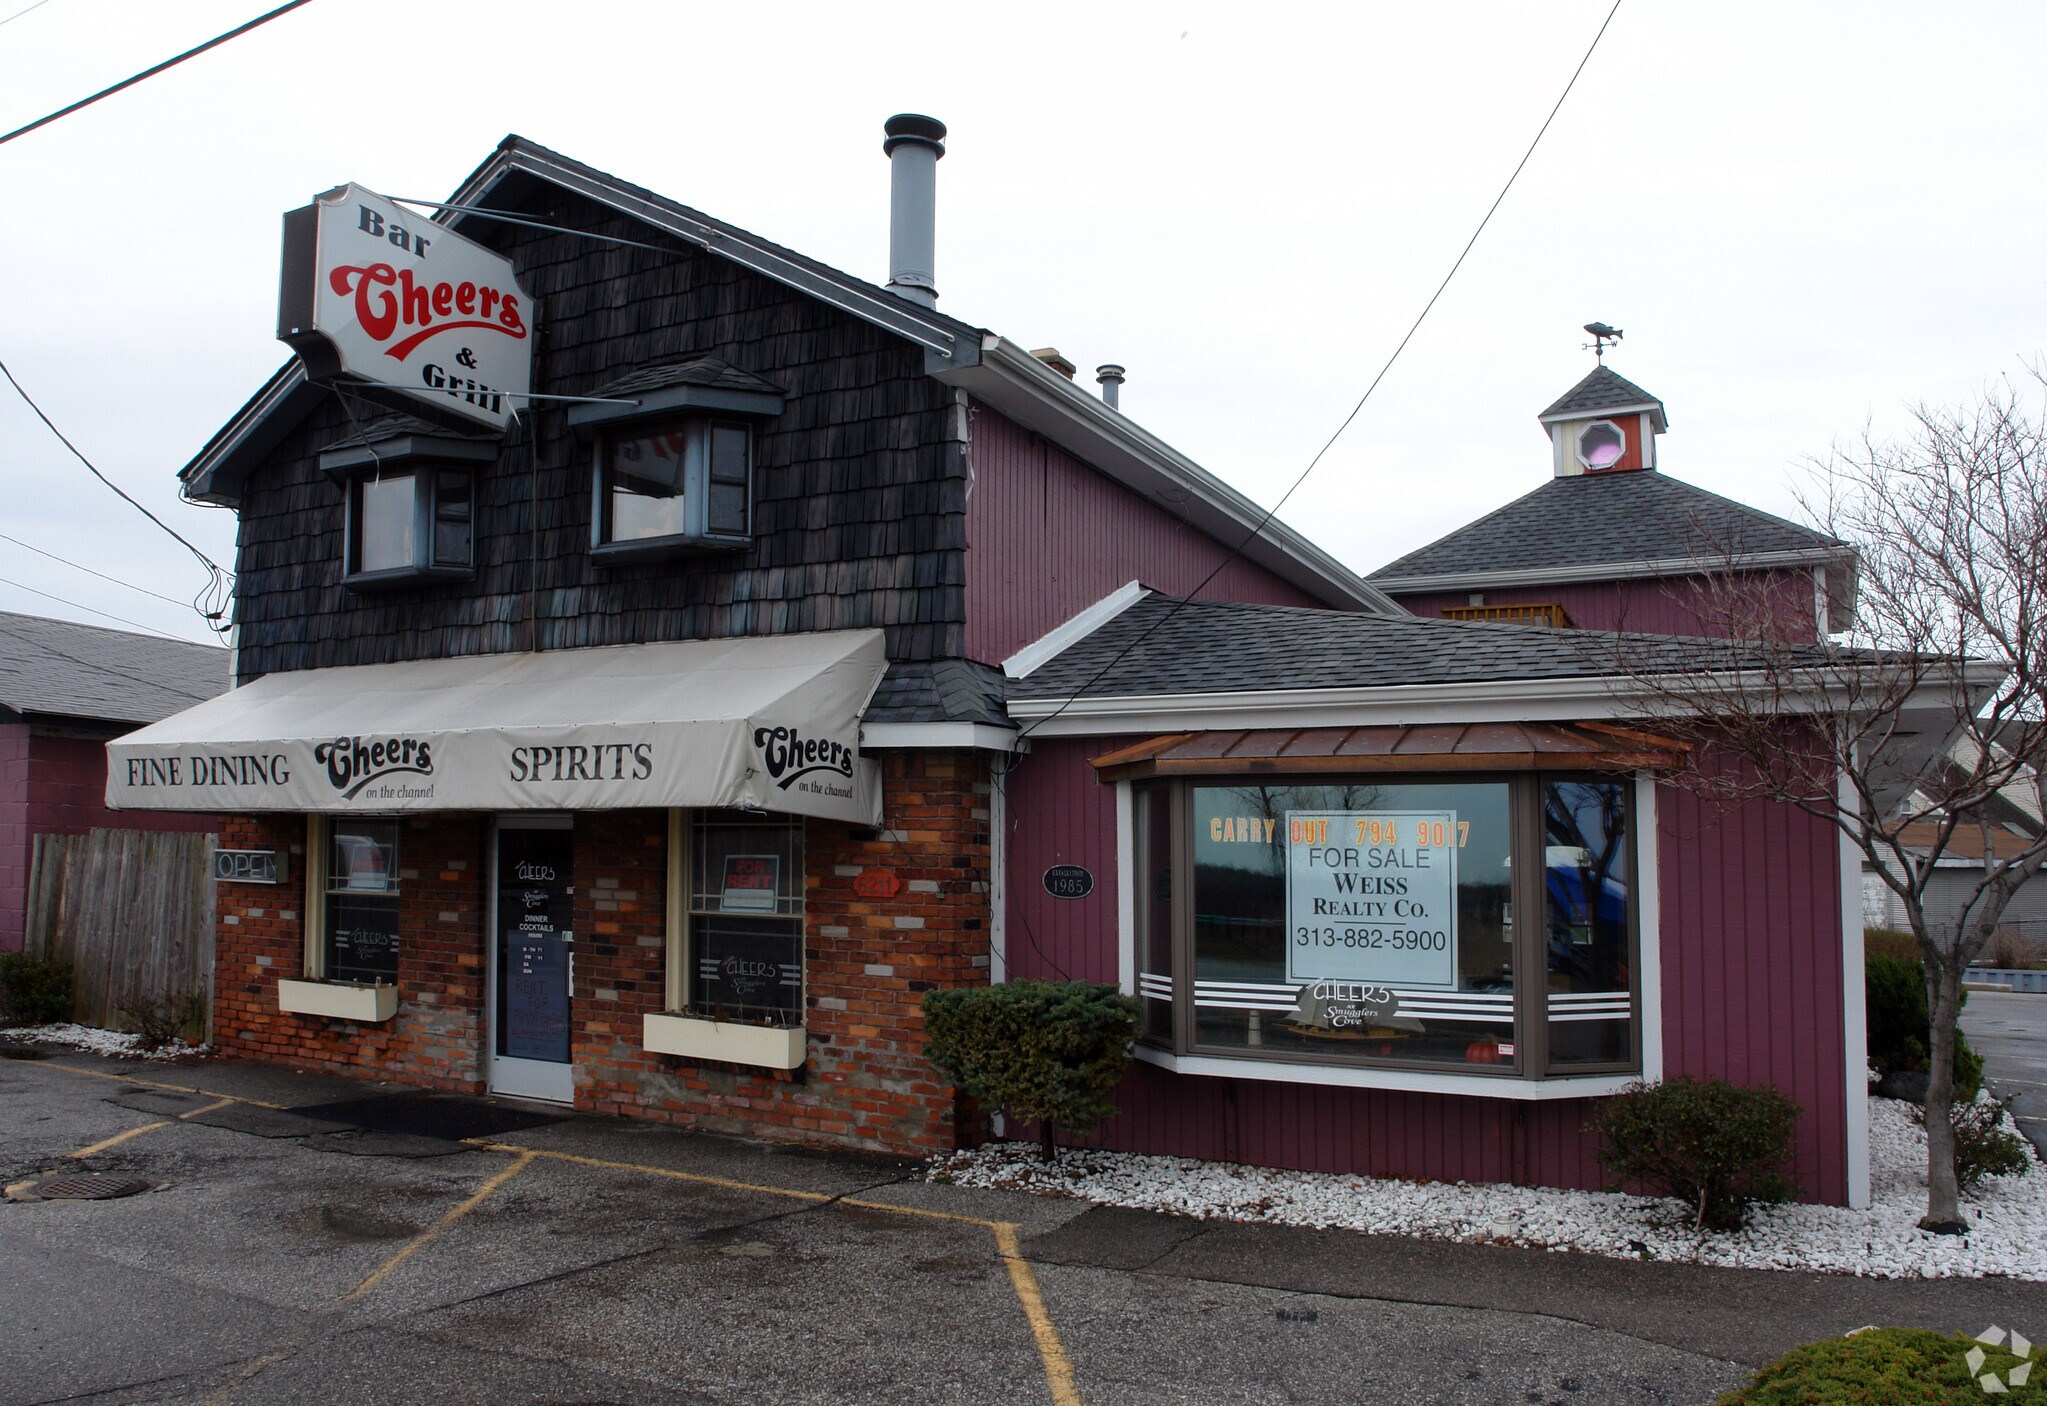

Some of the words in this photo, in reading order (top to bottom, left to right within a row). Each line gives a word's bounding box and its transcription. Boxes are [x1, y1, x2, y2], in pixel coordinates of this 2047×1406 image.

[358, 204, 431, 259] Bar
[329, 263, 526, 341] Cheers
[455, 347, 477, 369] &
[422, 363, 501, 414] Grill
[314, 736, 433, 790] Cheers
[510, 743, 652, 782] SPIRITS
[754, 726, 853, 779] Cheers
[126, 757, 183, 787] FINE
[191, 754, 290, 786] DINING
[366, 789, 377, 799] on
[380, 784, 395, 799] the
[397, 784, 434, 799] channel
[799, 782, 809, 792] on
[811, 780, 823, 794] the
[824, 782, 853, 799] channel
[1210, 817, 1275, 844] CARRY
[1291, 819, 1328, 845] OUT
[1356, 820, 1396, 845] 794
[1417, 821, 1470, 848] 9017
[219, 853, 276, 878] OPEN
[735, 859, 764, 873] FOR
[1309, 848, 1360, 868] FOR
[1368, 849, 1430, 869] SALE
[726, 874, 772, 889] RENT
[1054, 879, 1084, 893] 1985
[1332, 872, 1408, 895] WEISS
[1313, 897, 1387, 917] REALTY
[1394, 900, 1429, 918] CO.
[519, 923, 554, 932] COCKTAILS
[1296, 926, 1446, 951] 313-882-5900
[726, 957, 776, 978] CHEERS
[1313, 979, 1390, 1004] CHEERS
[1323, 1006, 1379, 1019] Smugglers
[1332, 1015, 1362, 1027] Cove
